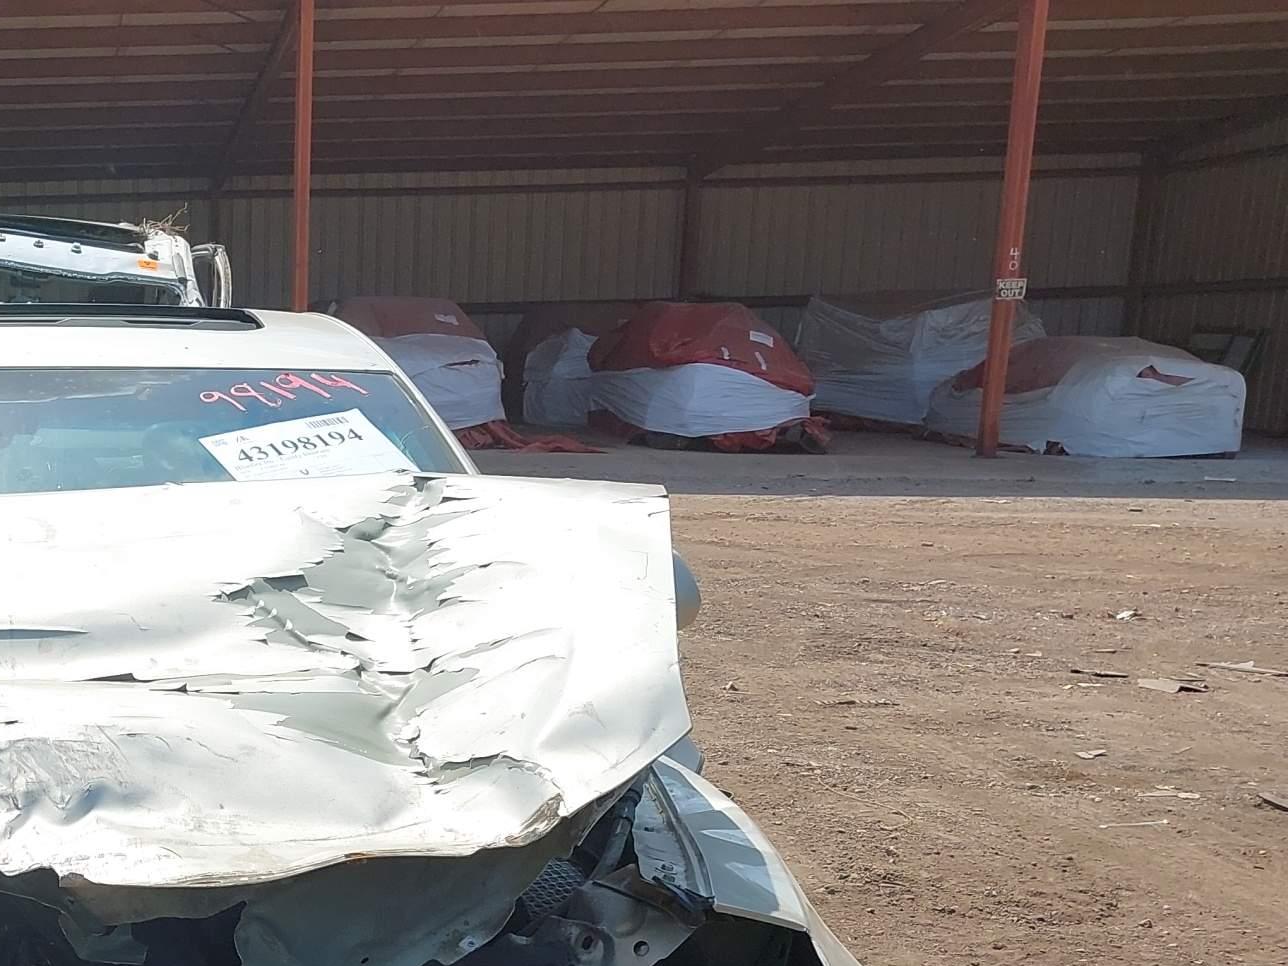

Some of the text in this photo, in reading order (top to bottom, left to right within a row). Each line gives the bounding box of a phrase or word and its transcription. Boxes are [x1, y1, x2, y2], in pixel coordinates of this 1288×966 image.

[999, 281, 1024, 289] KEEP
[1000, 289, 1021, 297] OUT
[237, 427, 364, 463] 43198194
